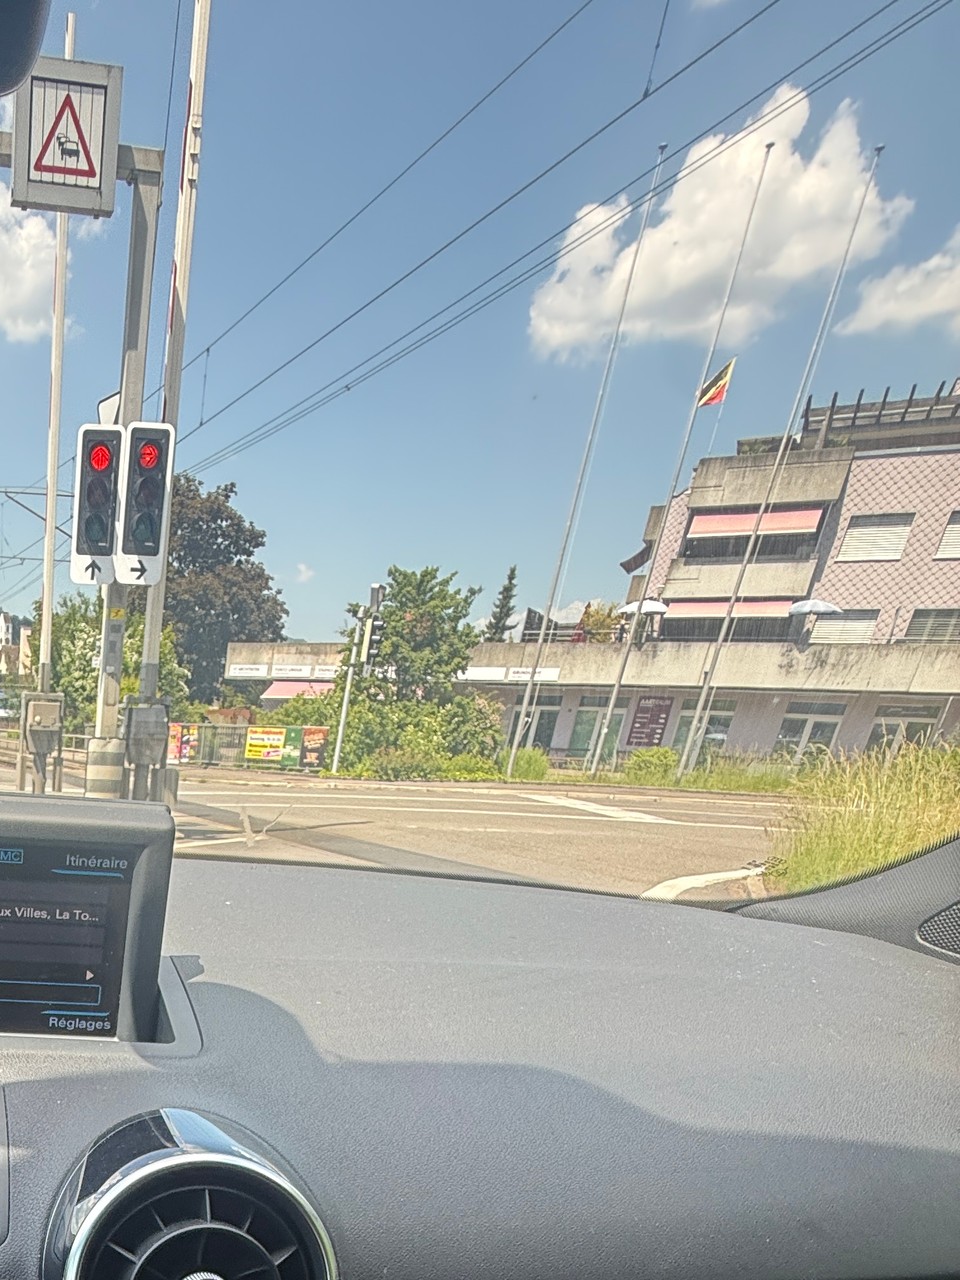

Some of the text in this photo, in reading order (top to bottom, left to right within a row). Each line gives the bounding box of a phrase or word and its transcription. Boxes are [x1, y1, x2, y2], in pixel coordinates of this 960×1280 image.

[66, 854, 128, 869] Itinéraire
[15, 906, 51, 920] Villes,
[55, 909, 70, 920] La
[74, 909, 99, 921] To...
[48, 1016, 111, 1031] Réglages
